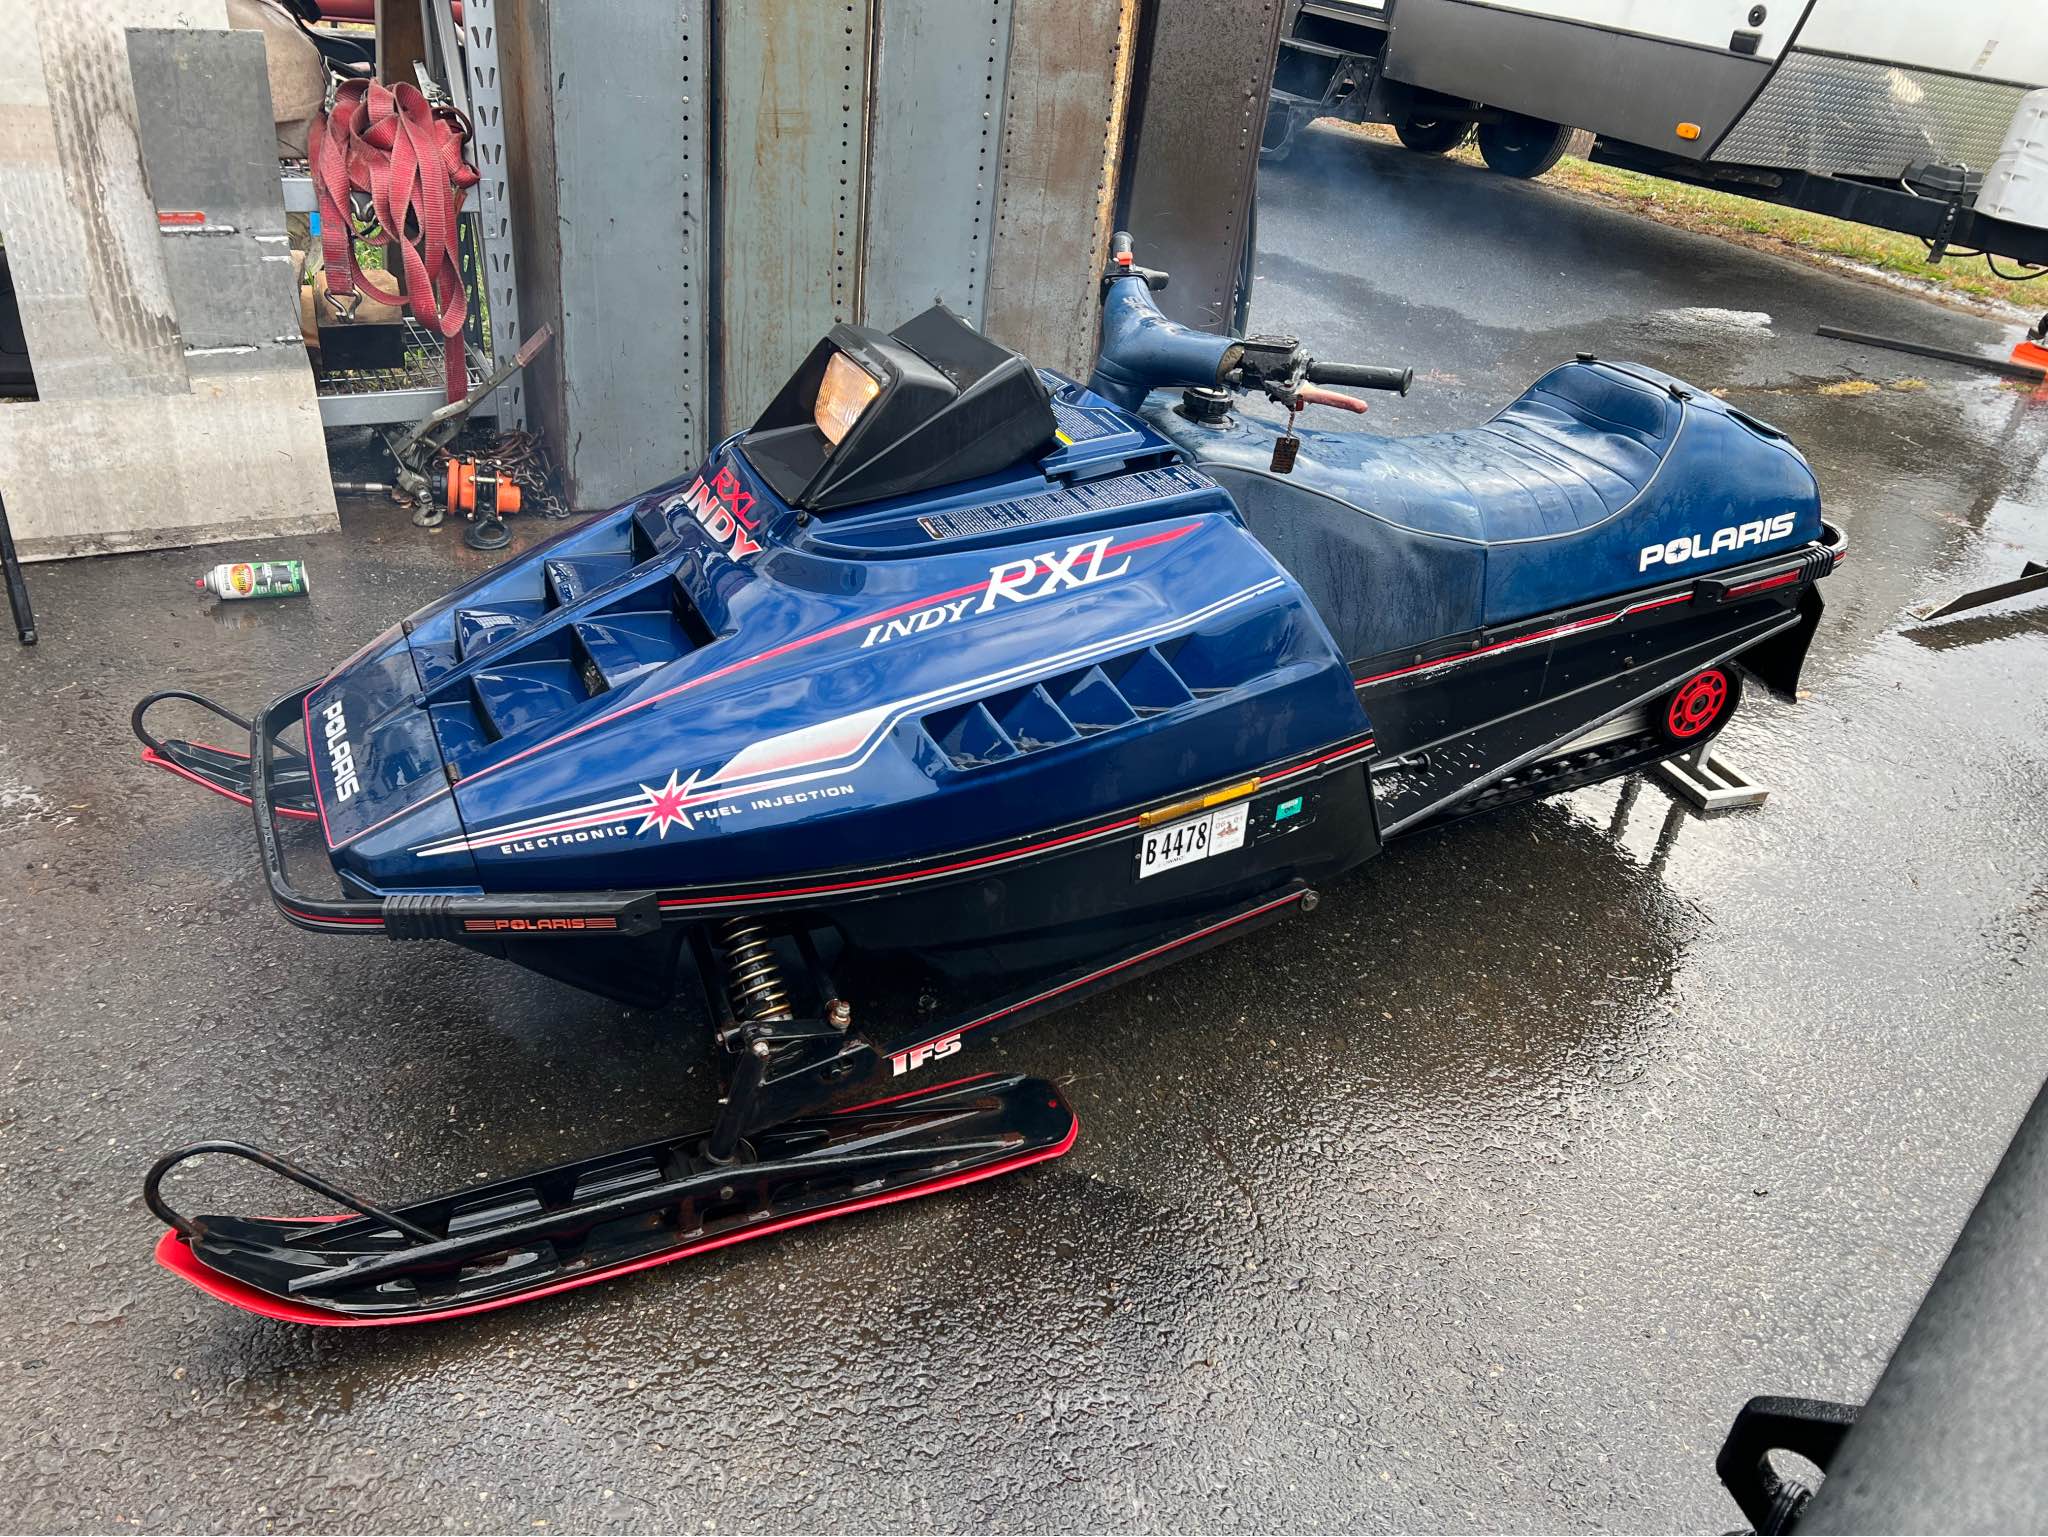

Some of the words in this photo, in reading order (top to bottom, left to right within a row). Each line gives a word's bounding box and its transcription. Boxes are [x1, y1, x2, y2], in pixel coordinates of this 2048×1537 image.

[682, 475, 763, 562] INDY
[710, 466, 761, 531] RXL
[1639, 511, 1798, 573] POLARIS
[860, 596, 976, 649] INDY
[975, 536, 1132, 614] RXL
[322, 700, 360, 803] POLARIS
[500, 825, 629, 855] ELECTRONIC
[693, 804, 743, 822] FUEL
[751, 784, 855, 811] INJECTION
[1145, 838, 1158, 866] B
[1161, 822, 1208, 859] 4478
[495, 918, 586, 930] POLARIS
[892, 1033, 962, 1078] IFS
